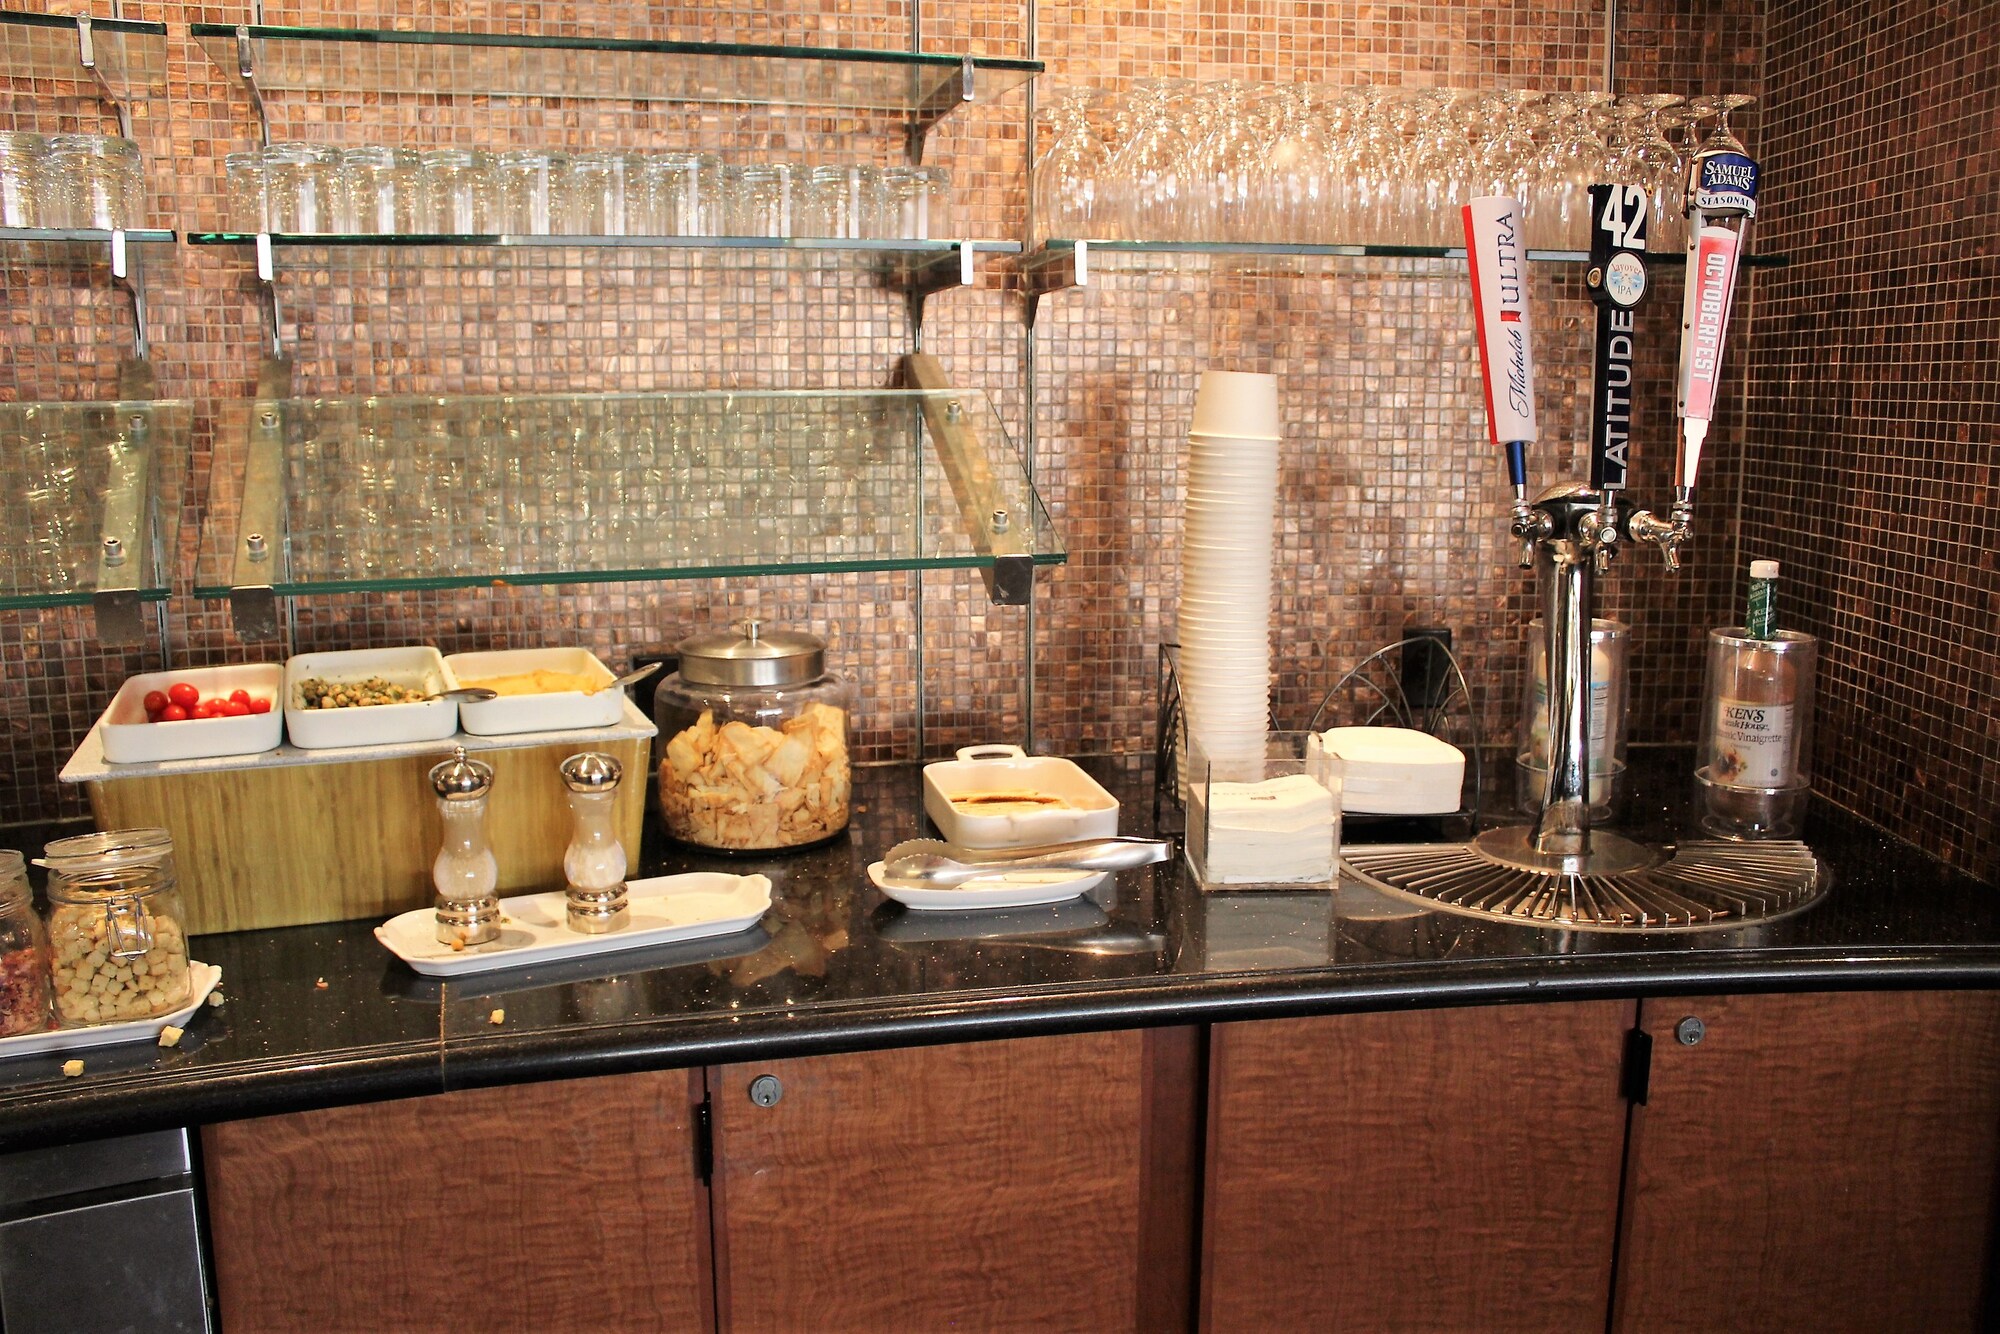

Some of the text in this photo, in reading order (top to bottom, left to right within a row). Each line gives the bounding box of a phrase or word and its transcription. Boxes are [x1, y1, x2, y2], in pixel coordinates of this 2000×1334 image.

[1705, 161, 1755, 180] SAMUEL
[1707, 174, 1750, 190] ADAMS
[1701, 196, 1750, 207] SEASONAL
[1601, 184, 1647, 250] 42
[1617, 285, 1633, 296] IPA
[1496, 212, 1529, 418] Michelob ULTRA
[1693, 253, 1727, 383] OCTOBERFEST
[1604, 309, 1634, 490] LATITUDE
[1724, 707, 1765, 723] KEN'S
[1737, 731, 1782, 745] Vinaigrette
